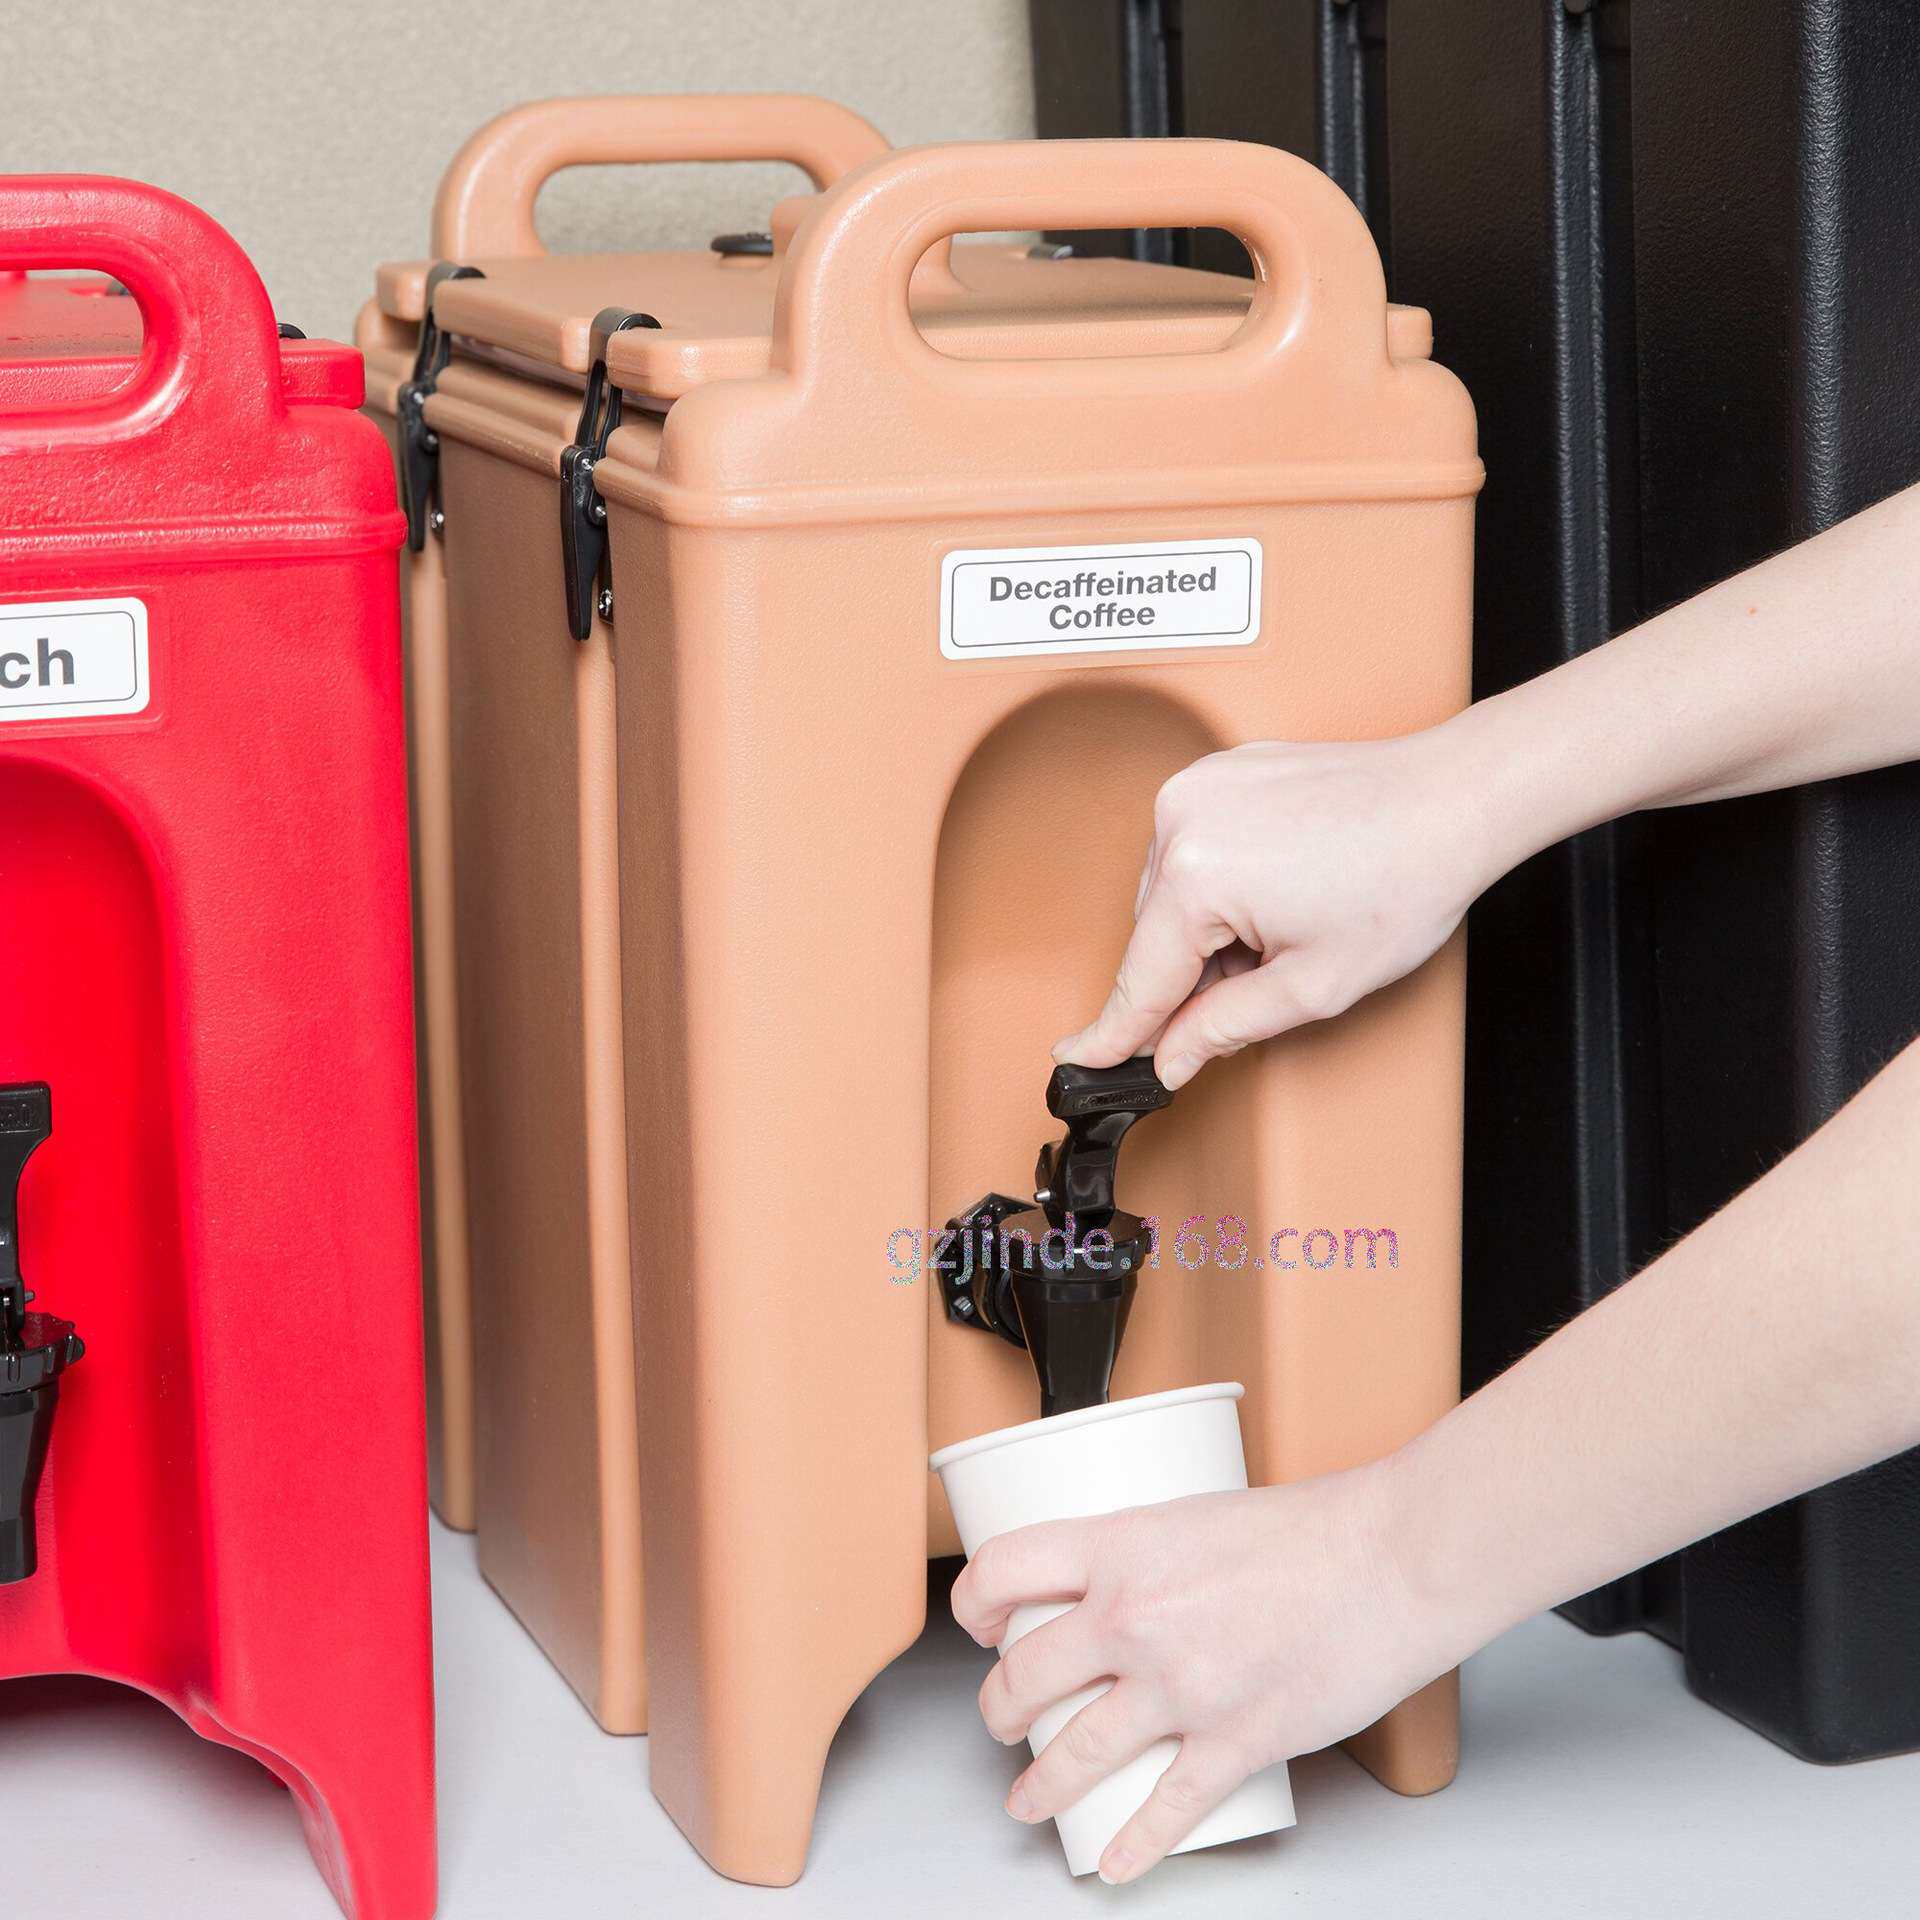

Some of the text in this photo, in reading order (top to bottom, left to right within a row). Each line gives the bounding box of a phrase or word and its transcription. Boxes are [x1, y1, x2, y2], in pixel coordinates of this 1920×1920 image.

[989, 566, 1217, 601] Decaffeinated
[1049, 602, 1156, 630] Coffee
[0, 637, 75, 689] ch
